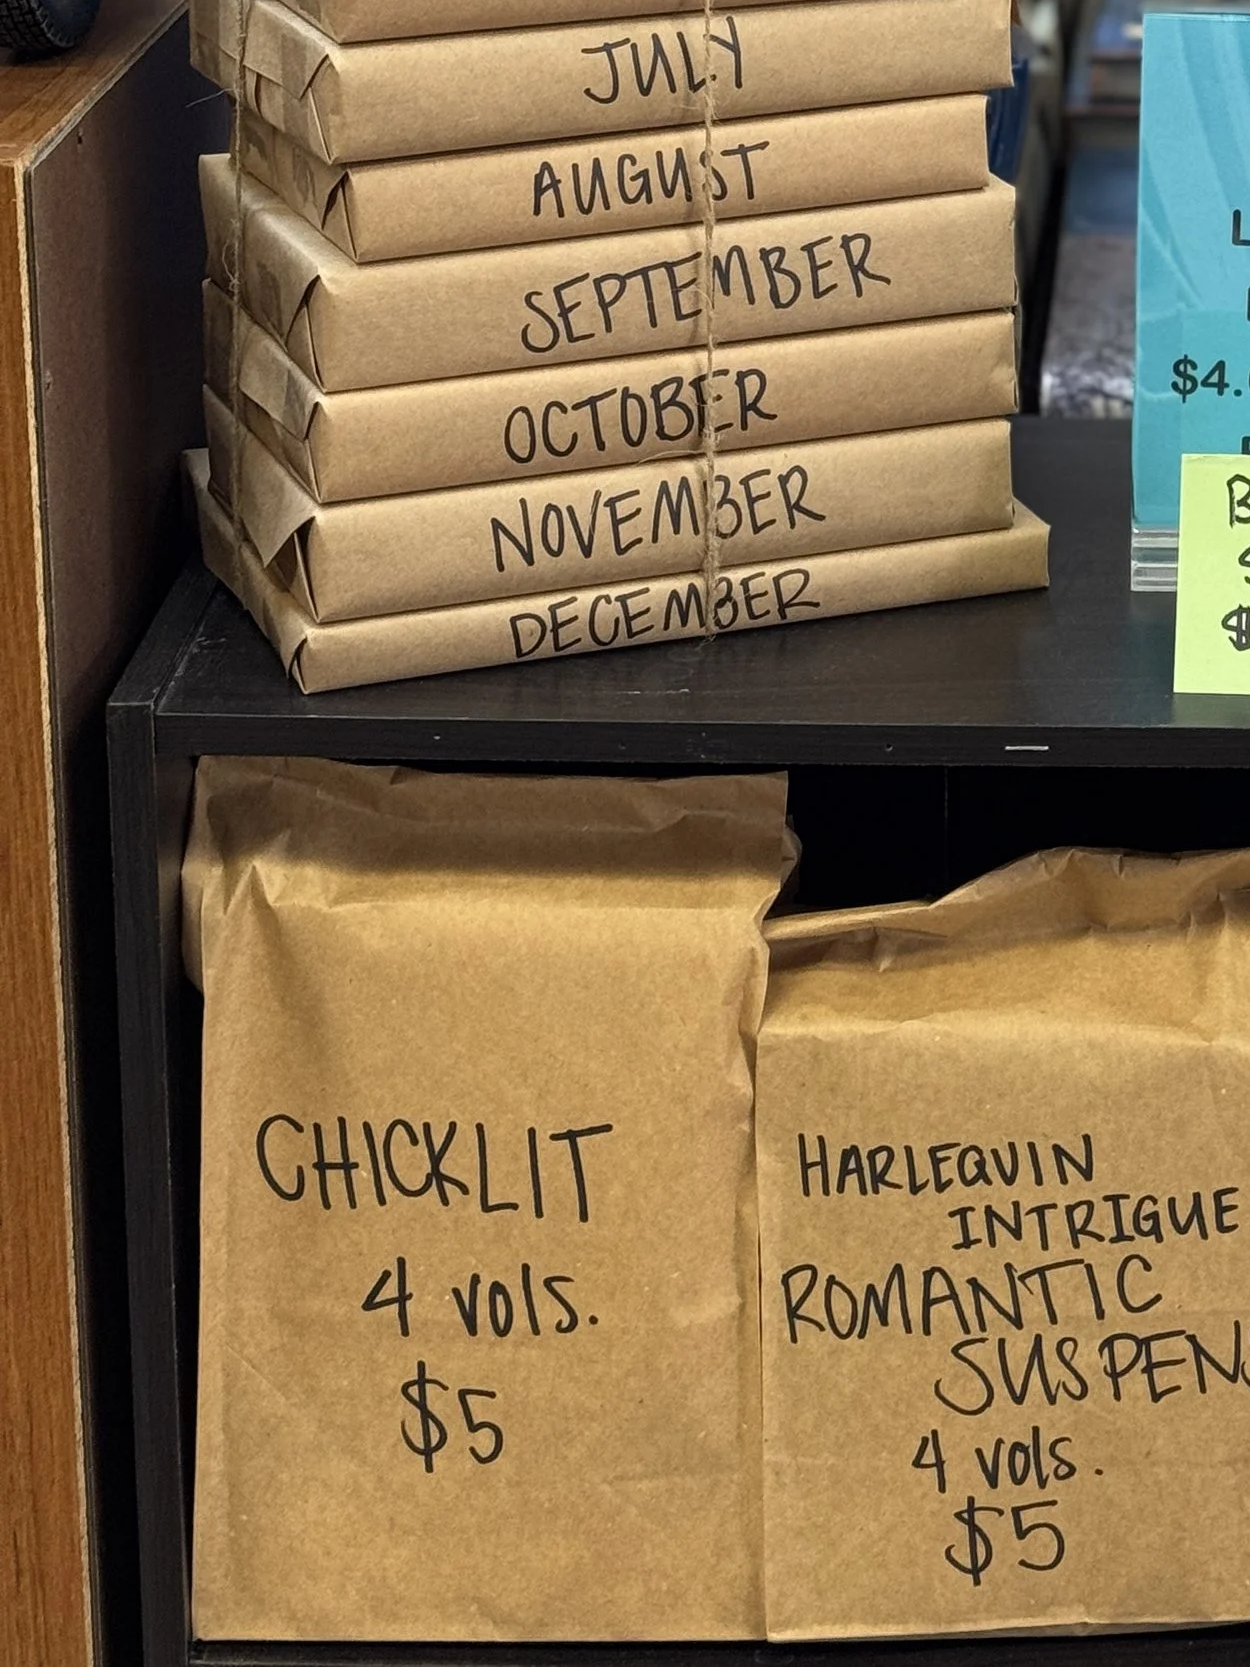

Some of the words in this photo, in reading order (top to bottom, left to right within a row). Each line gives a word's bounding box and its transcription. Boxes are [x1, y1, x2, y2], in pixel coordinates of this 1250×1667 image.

[581, 15, 743, 105] JULY
[533, 140, 770, 218] AUGUST
[520, 233, 892, 353] SEPTEMBER
[504, 368, 778, 463] OCTOBER
[490, 465, 826, 573] NOVEMBER
[509, 568, 821, 658] DECEMBER
[255, 1113, 614, 1223] CHICKLIT
[798, 1133, 1095, 1197] HARLEQUIN
[947, 1187, 1240, 1251] INTRIGUE
[361, 1256, 414, 1338] 4
[452, 1262, 599, 1338] vols.
[781, 1254, 1163, 1344] ROMANTIC
[399, 1360, 505, 1473] $5
[911, 1428, 947, 1494] 4
[975, 1425, 1104, 1490] vols.
[944, 1496, 1066, 1586] $5
